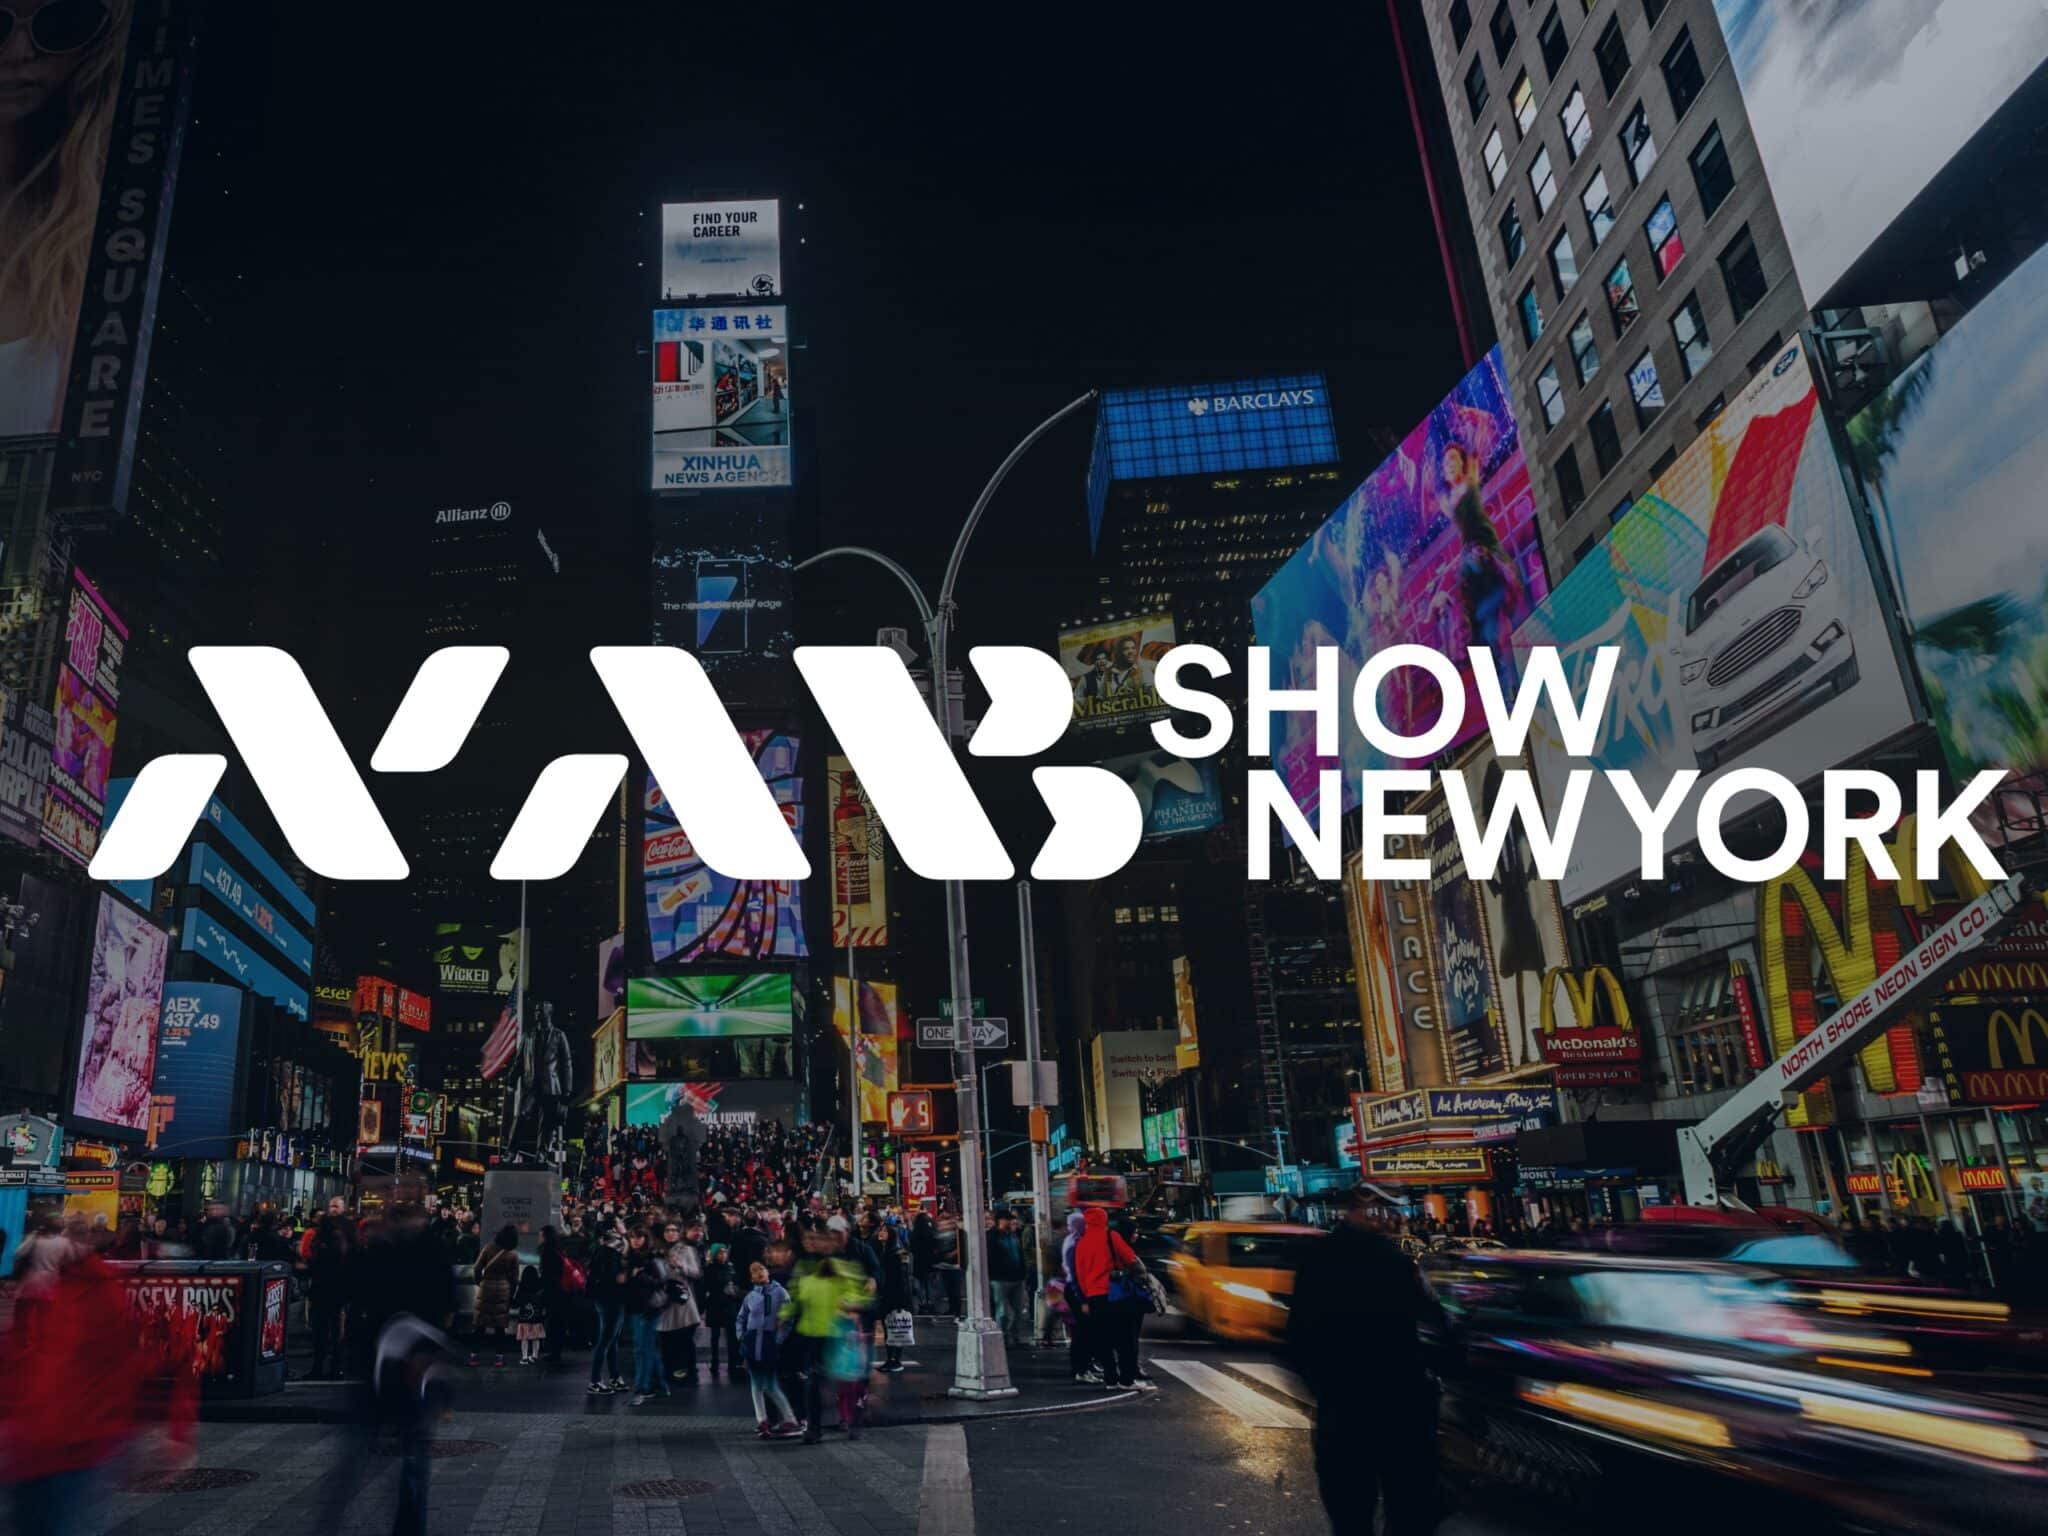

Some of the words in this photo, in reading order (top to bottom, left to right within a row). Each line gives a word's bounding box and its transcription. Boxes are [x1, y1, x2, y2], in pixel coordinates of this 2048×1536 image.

[693, 213, 721, 225] FIND
[725, 211, 758, 224] YOUR
[693, 225, 740, 238] CAREER
[80, 187, 147, 438] SQUARE
[1213, 389, 1314, 413] BARCLAYS
[682, 456, 760, 471] XINHUA
[71, 469, 103, 482] NYC
[664, 472, 709, 485] NEWS
[434, 508, 488, 524] Allianz
[1153, 801, 1217, 821] PHANTOM
[647, 835, 690, 861] Coca-Cola
[1780, 1033, 1825, 1080] NORTH
[1826, 996, 1874, 1044] SHORE
[1874, 959, 1919, 1006] NEON
[1919, 927, 1959, 970] SIGN
[1958, 906, 1990, 938] CO.
[165, 997, 200, 1013] AEX
[164, 1012, 220, 1030] 437.49
[926, 1027, 953, 1040] ONE
[1546, 1036, 1638, 1051] McDonald's
[1110, 1054, 1140, 1064] Switch
[1111, 1068, 1140, 1078] Switch
[721, 1111, 757, 1124] LUXURY
[910, 1156, 930, 1196] tkts
[1519, 1170, 1557, 1180] MONEY
